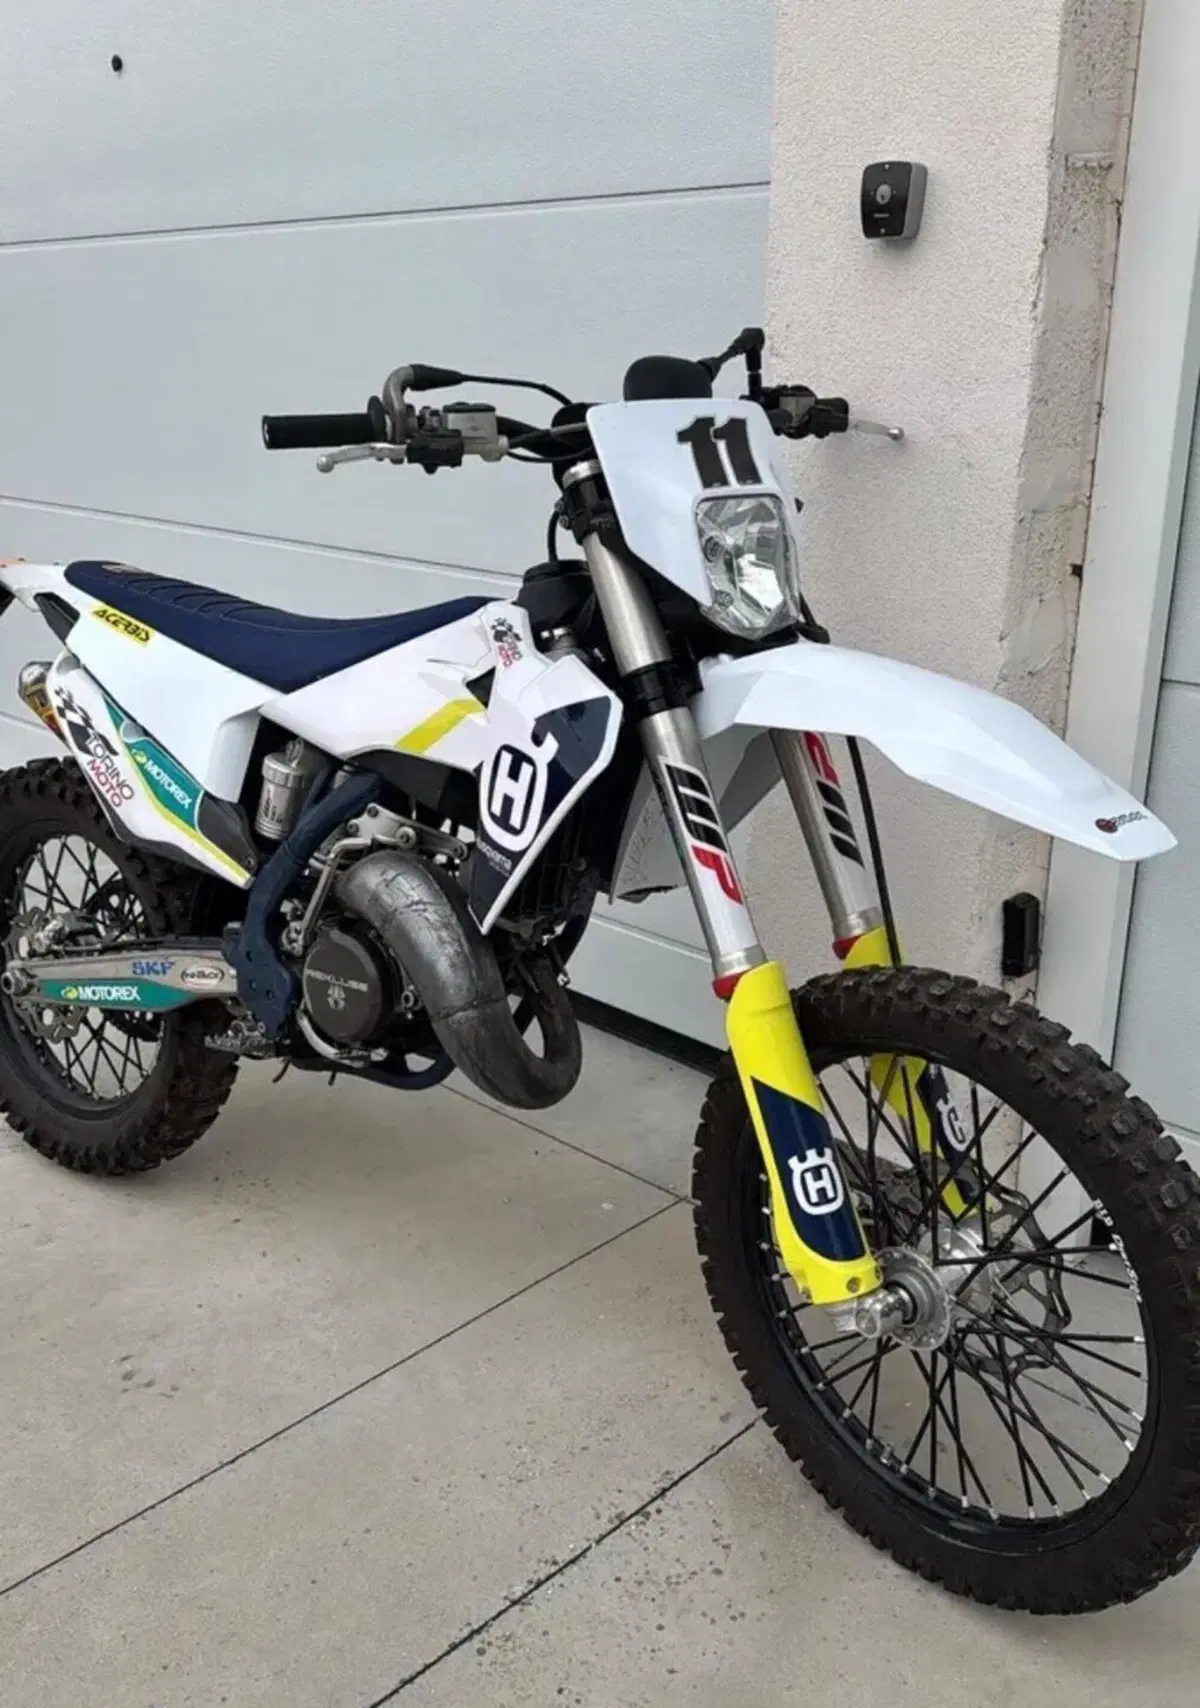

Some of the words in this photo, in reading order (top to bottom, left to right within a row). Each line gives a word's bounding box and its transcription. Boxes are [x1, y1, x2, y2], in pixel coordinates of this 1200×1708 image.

[676, 415, 764, 489] 11
[92, 606, 151, 644] ACERBIS
[84, 733, 134, 801] TORINO
[87, 758, 123, 808] MOTO
[143, 757, 193, 809] MOTOREX
[78, 985, 141, 1001] MOTOREX
[131, 960, 175, 976] SKF
